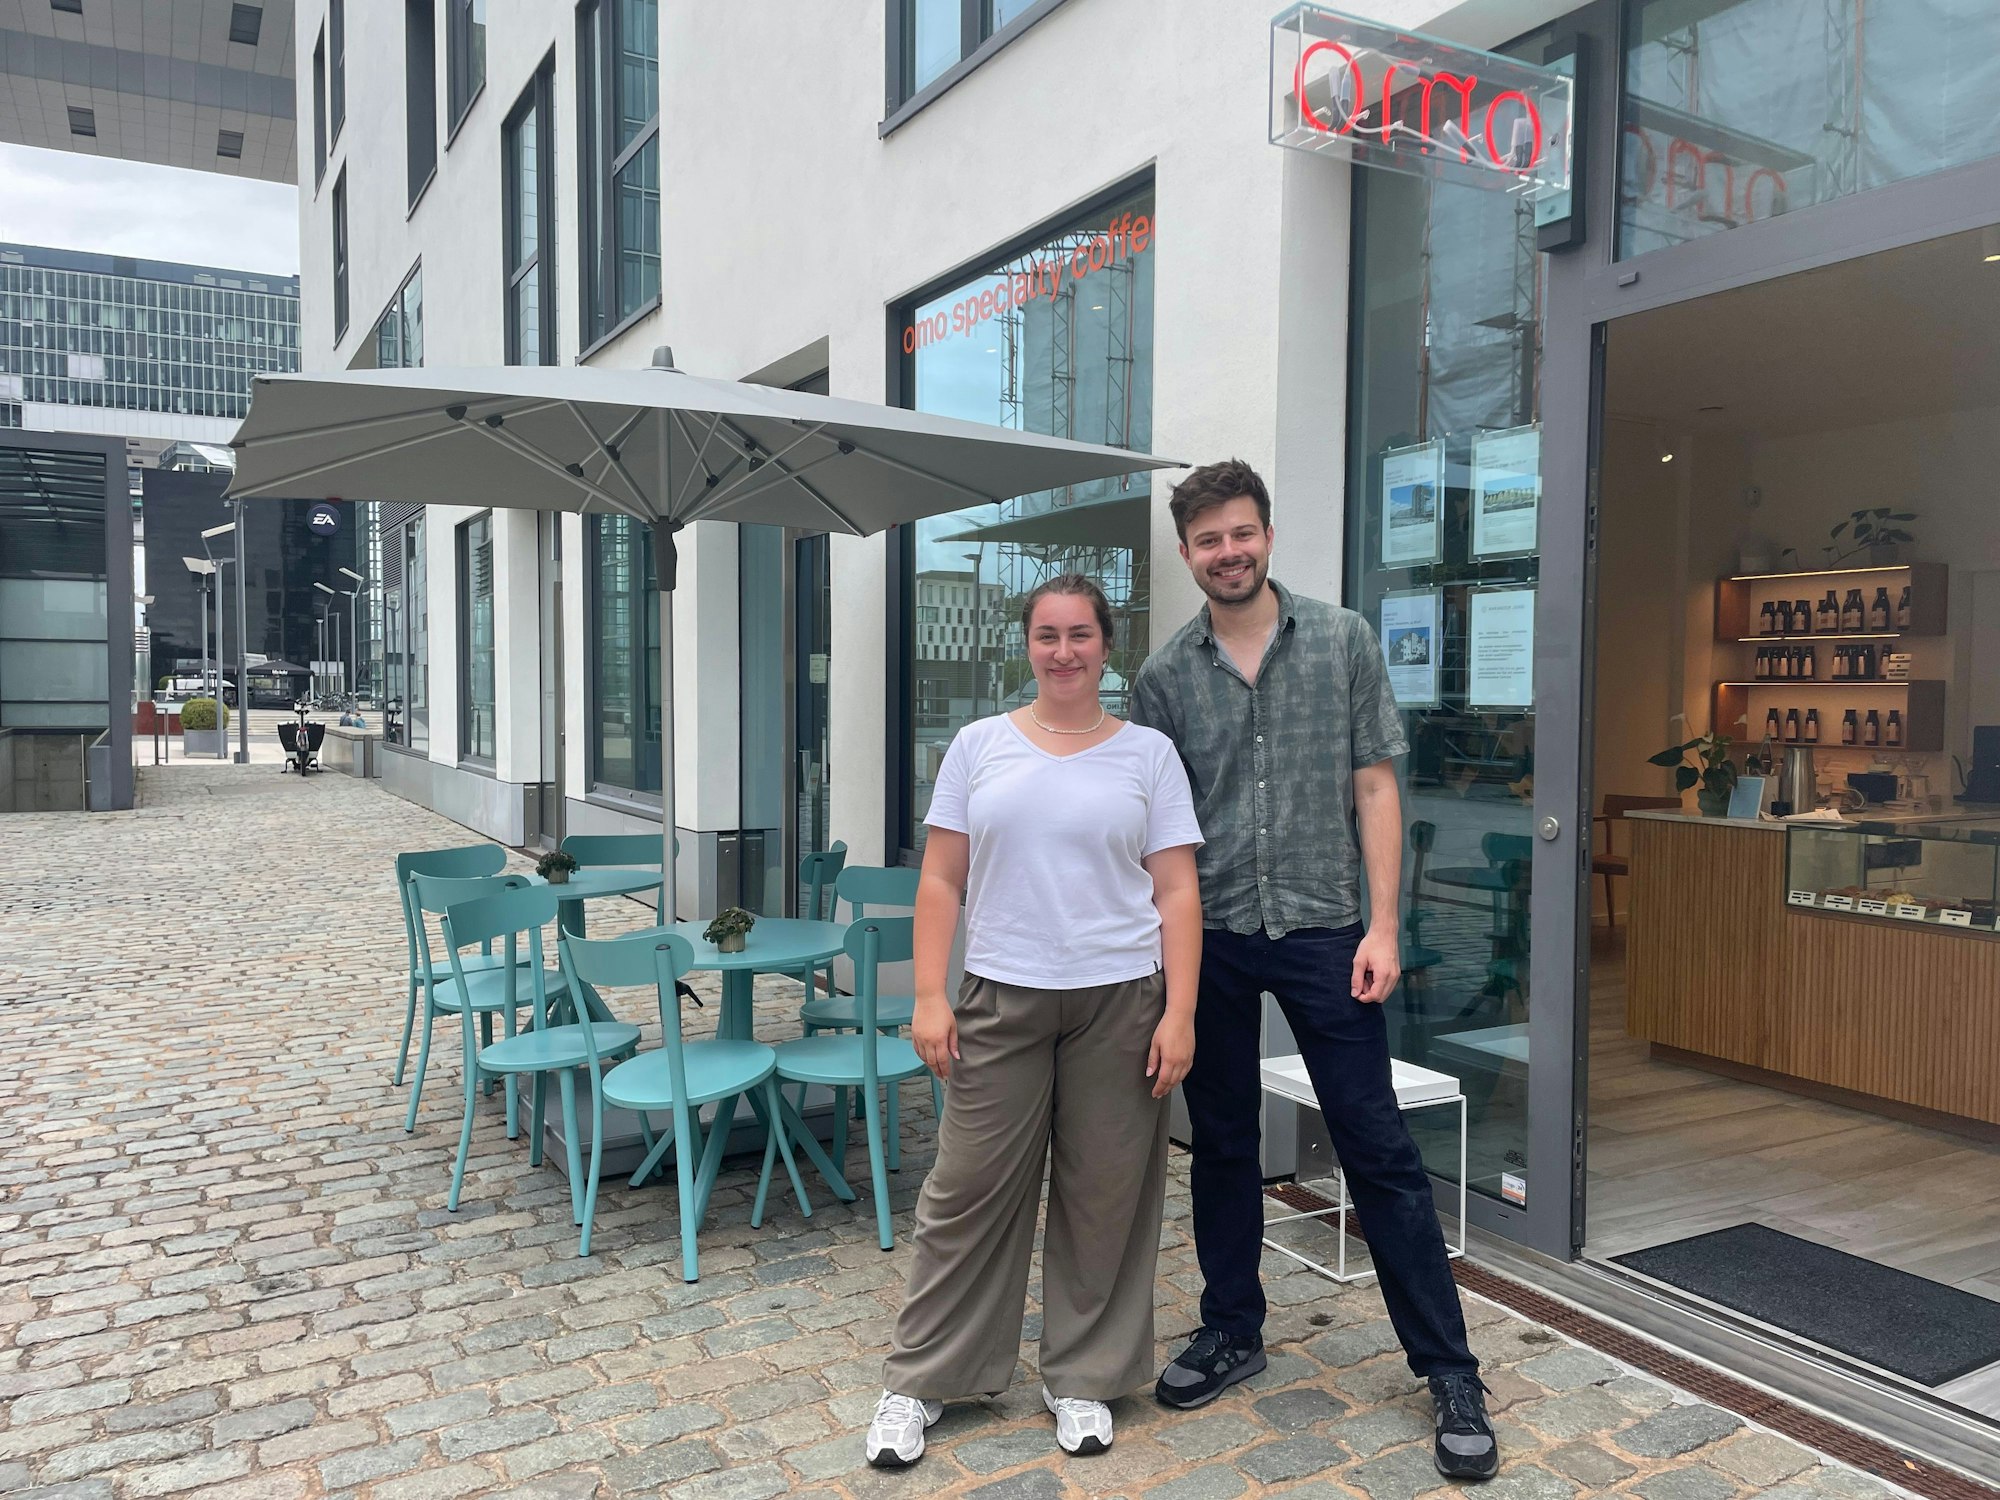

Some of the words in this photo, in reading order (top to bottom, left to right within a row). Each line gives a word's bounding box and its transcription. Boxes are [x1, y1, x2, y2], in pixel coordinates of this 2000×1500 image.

[1294, 40, 1542, 176] omo
[903, 312, 947, 354] omo
[952, 256, 1064, 338] specialty
[1071, 211, 1155, 279] coffe
[312, 513, 336, 526] EA
